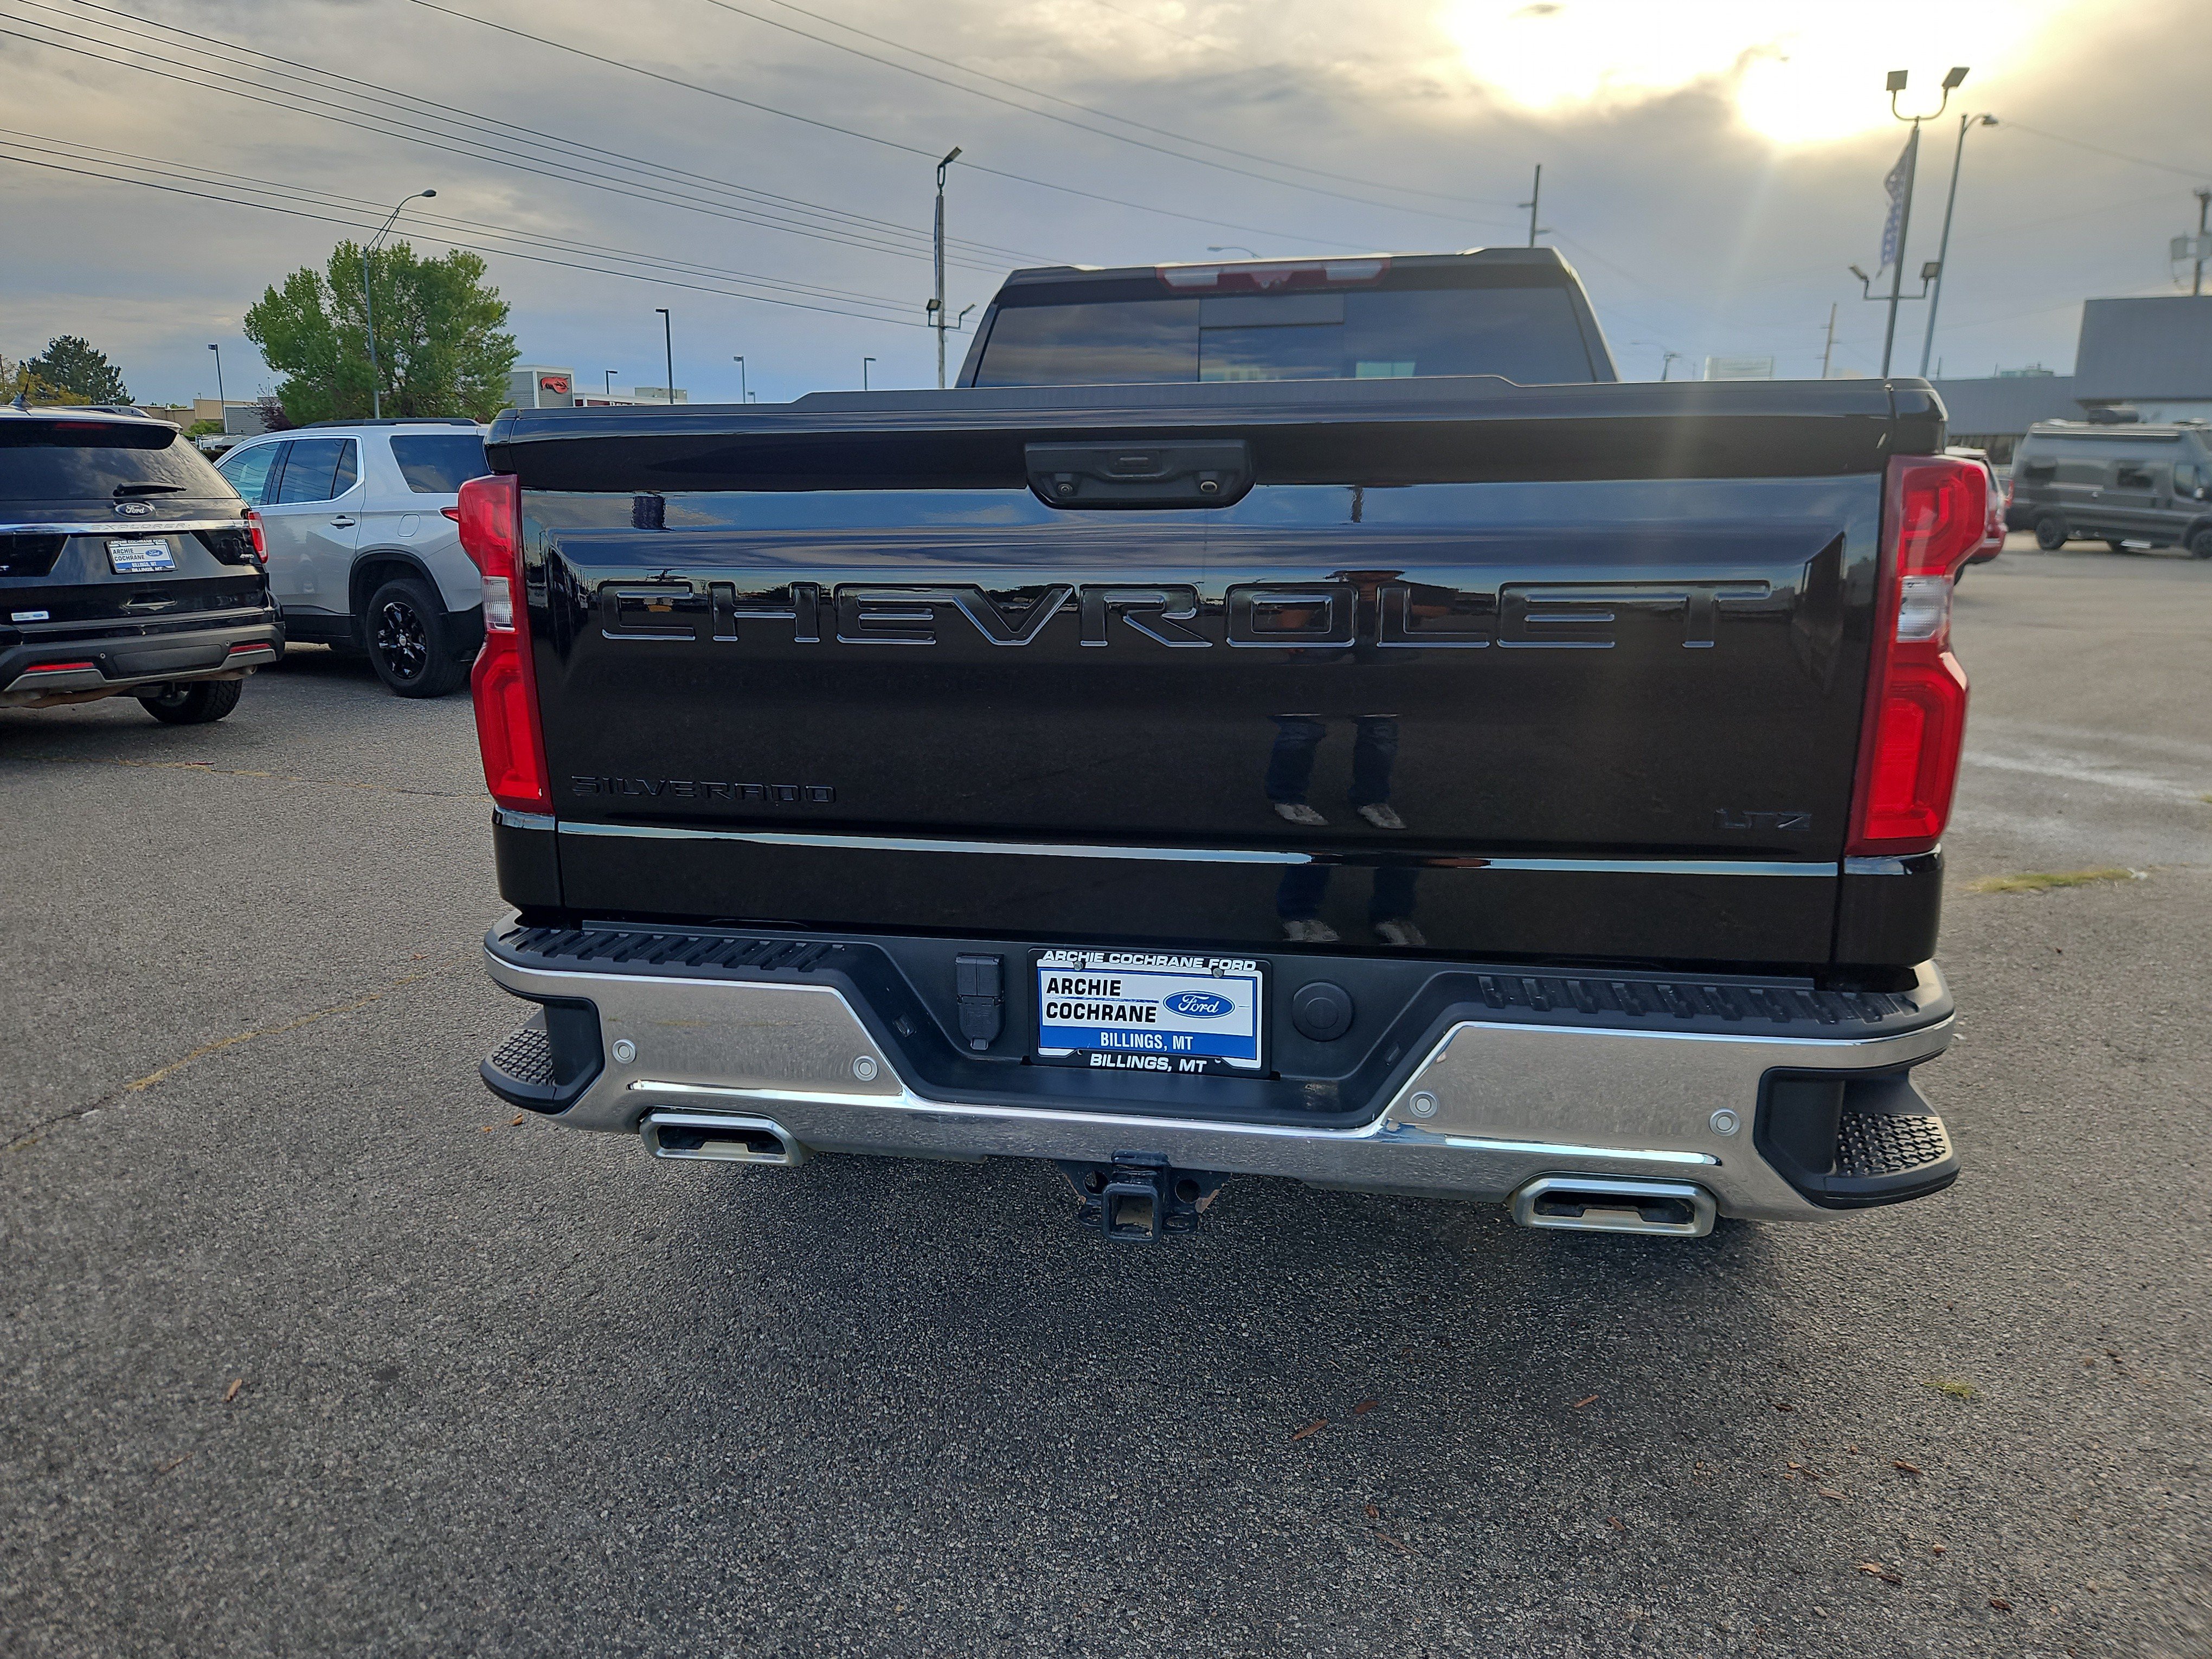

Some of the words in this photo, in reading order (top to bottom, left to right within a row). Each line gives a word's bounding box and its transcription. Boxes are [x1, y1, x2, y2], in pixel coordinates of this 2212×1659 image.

[125, 505, 145, 513] Ford
[597, 580, 1772, 648] CHEVROLET
[571, 775, 837, 803] SILVERADO
[1713, 809, 1812, 831] LTZ
[1042, 950, 1105, 963] ARCHIE
[1109, 953, 1205, 969] COCHRANE
[1208, 958, 1257, 972] FORD
[1046, 977, 1122, 996] ARCHIE
[1046, 1001, 1157, 1024] COCHRANE
[1178, 993, 1219, 1014] Ford
[1100, 1032, 1168, 1052] BILLINGS,
[1172, 1035, 1194, 1051] MT
[1090, 1053, 1172, 1072] BILLINGS,
[1179, 1059, 1207, 1073] MT
